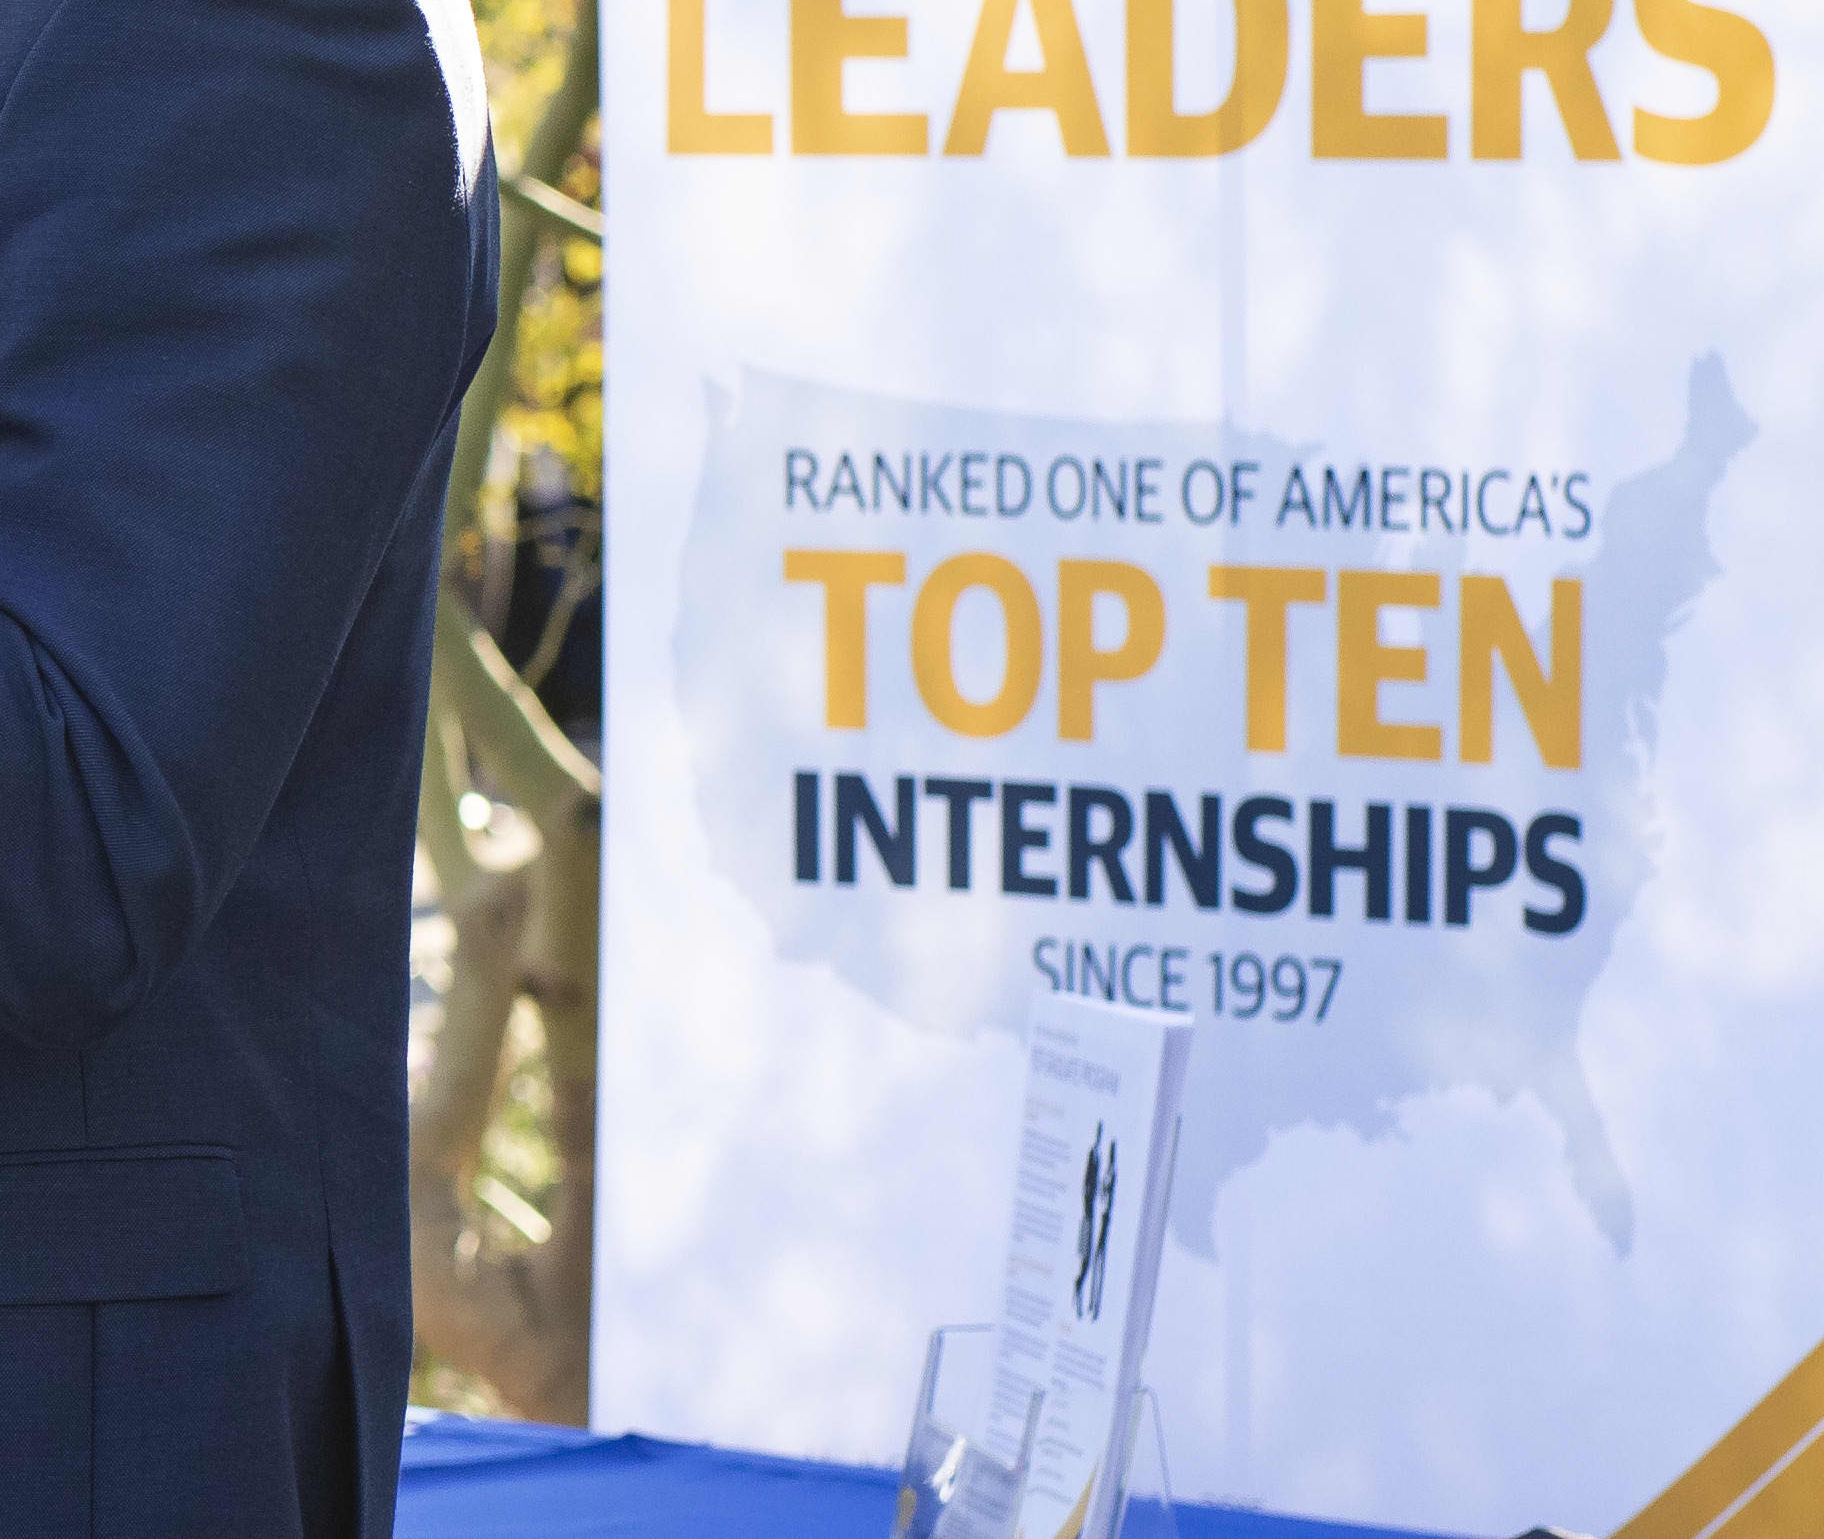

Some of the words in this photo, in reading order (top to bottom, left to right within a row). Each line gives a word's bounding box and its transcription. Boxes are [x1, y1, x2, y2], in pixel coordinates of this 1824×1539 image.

[783, 447, 1035, 521] RANKED
[1046, 454, 1163, 528] ONE
[1180, 459, 1259, 530] OF
[1275, 464, 1593, 540] AMERICA'S
[783, 549, 1166, 744] TOP
[1208, 562, 1585, 771] TEN
[791, 769, 1587, 937] INTERNSHIPS
[1032, 935, 1190, 1012] SINCE
[1209, 950, 1343, 1025] 1997
